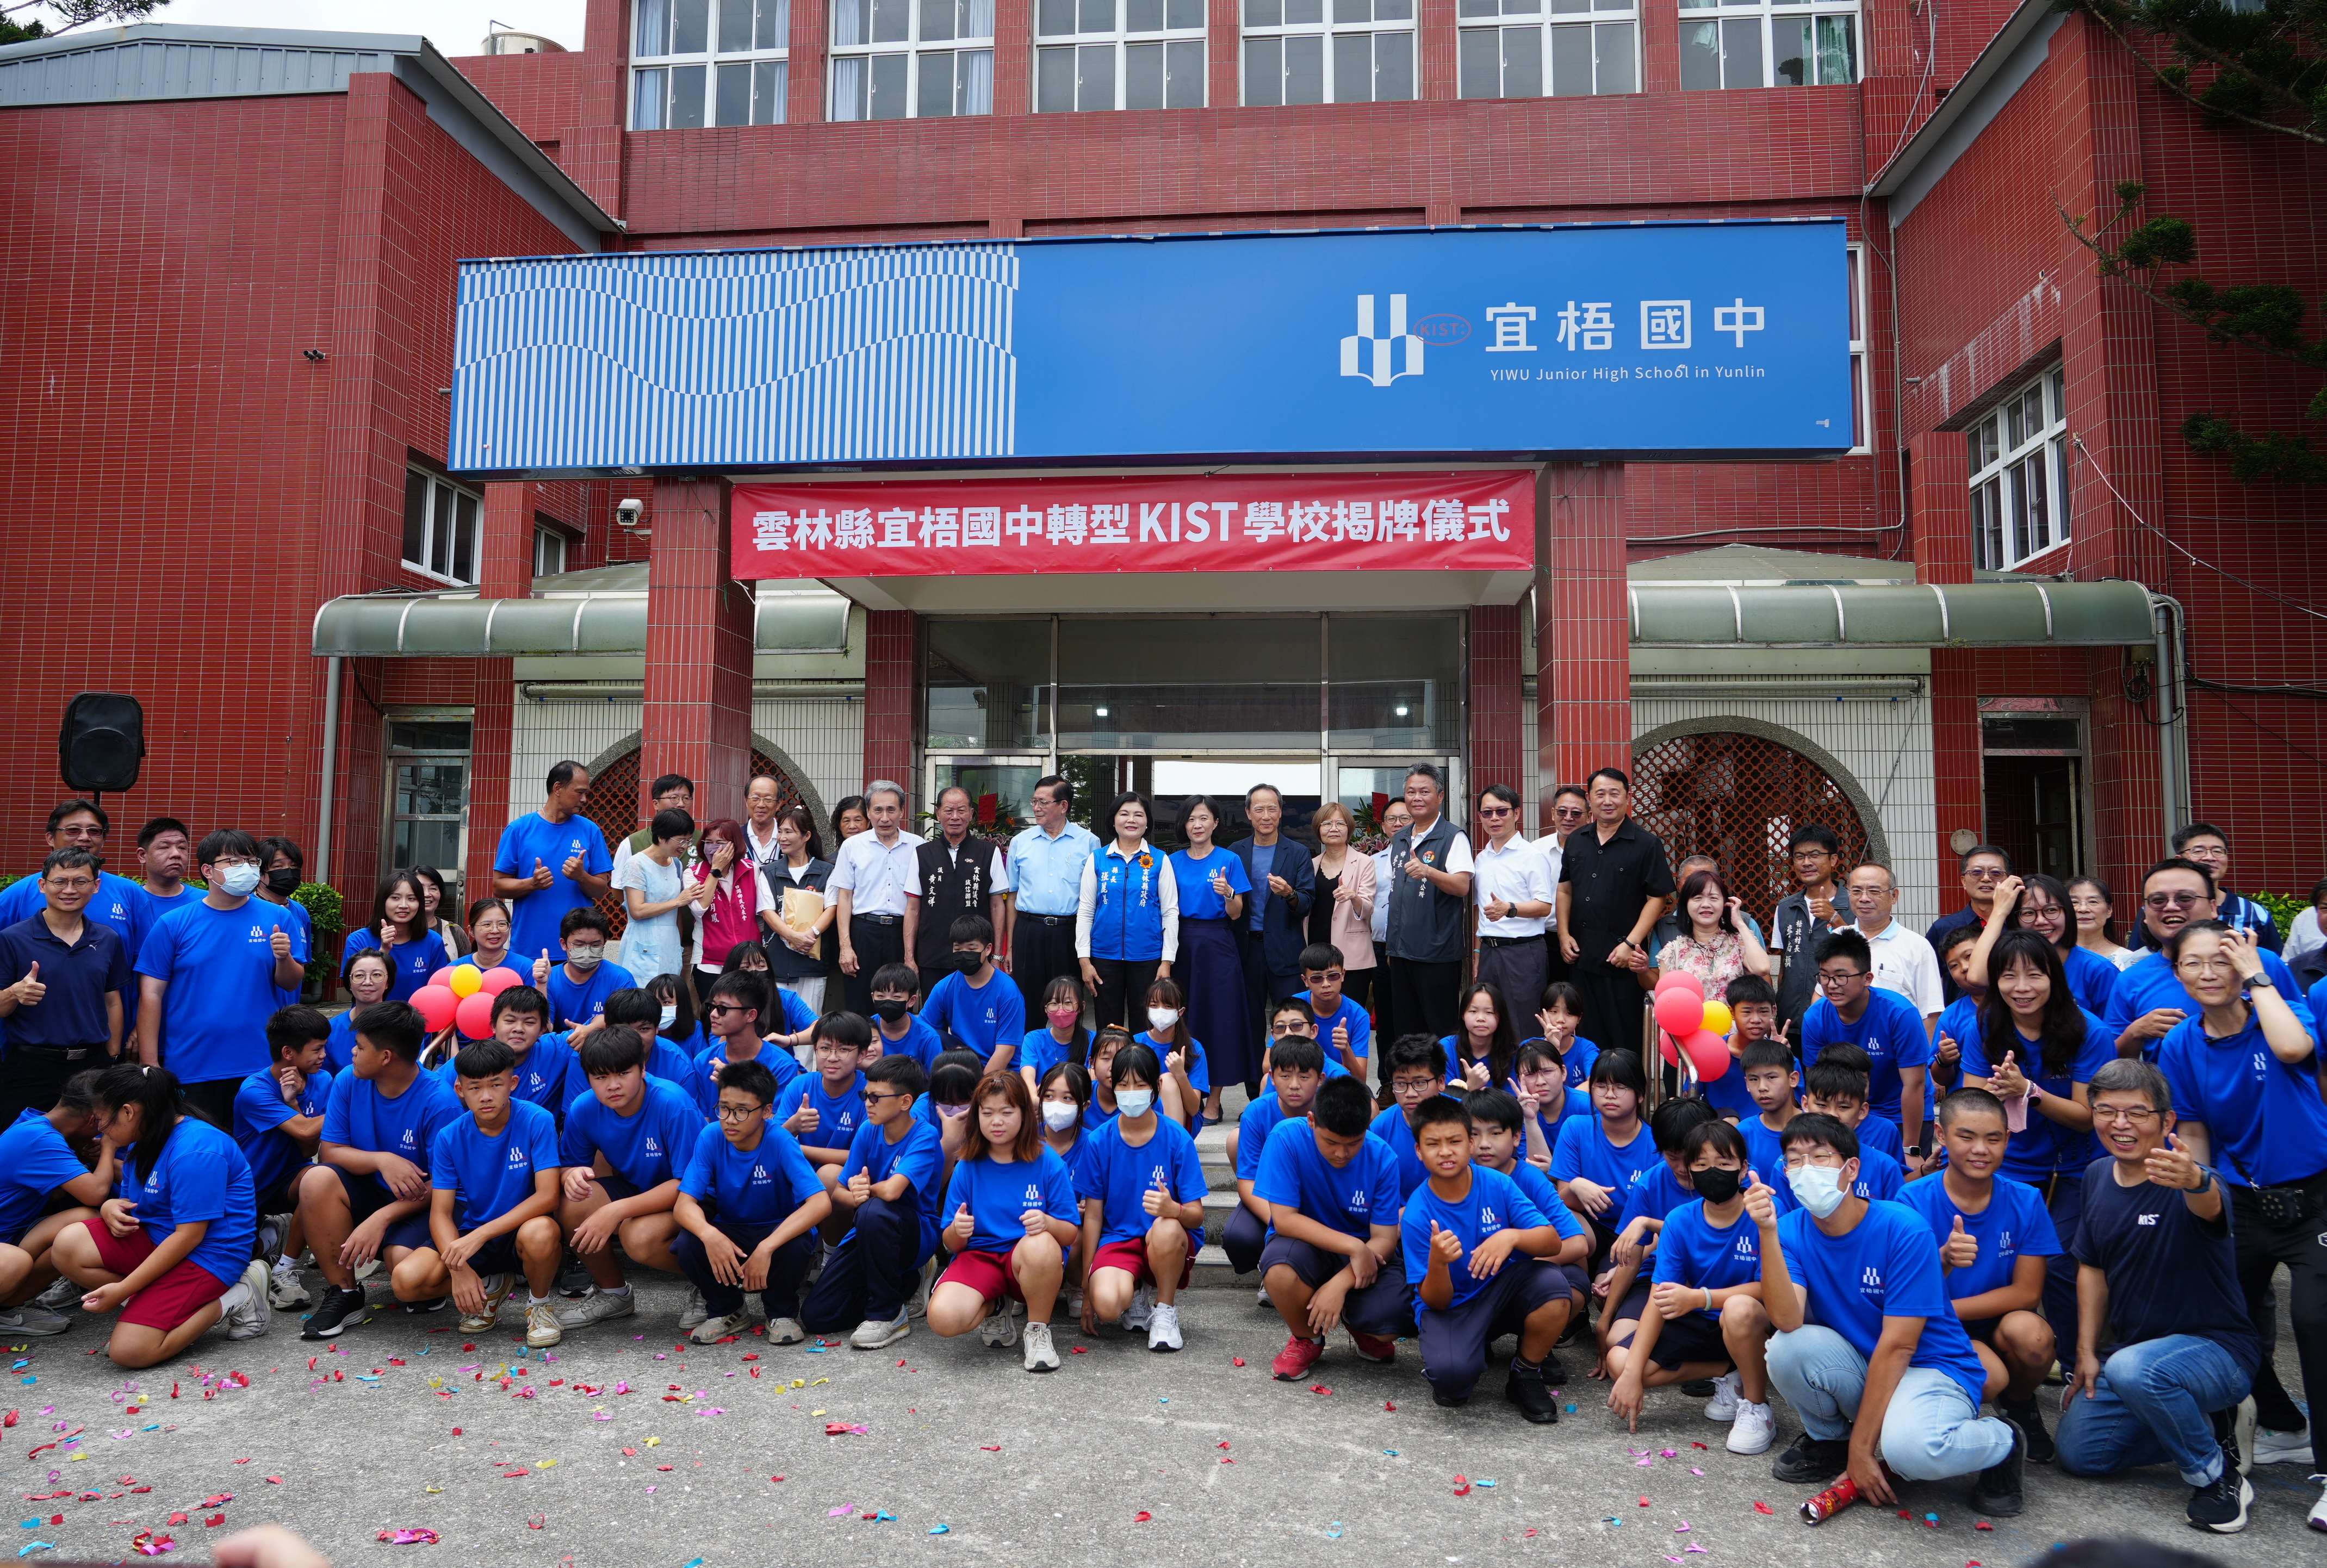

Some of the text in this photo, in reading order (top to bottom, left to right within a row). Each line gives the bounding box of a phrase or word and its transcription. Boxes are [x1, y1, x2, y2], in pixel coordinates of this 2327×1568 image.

[1486, 298, 1764, 351] 宜梧國中
[1491, 365, 1765, 382] YIWU Junior High School in Yunlin
[753, 499, 1510, 551] 雲林縣宜梧國中轉型KIST學校揭牌儀式
